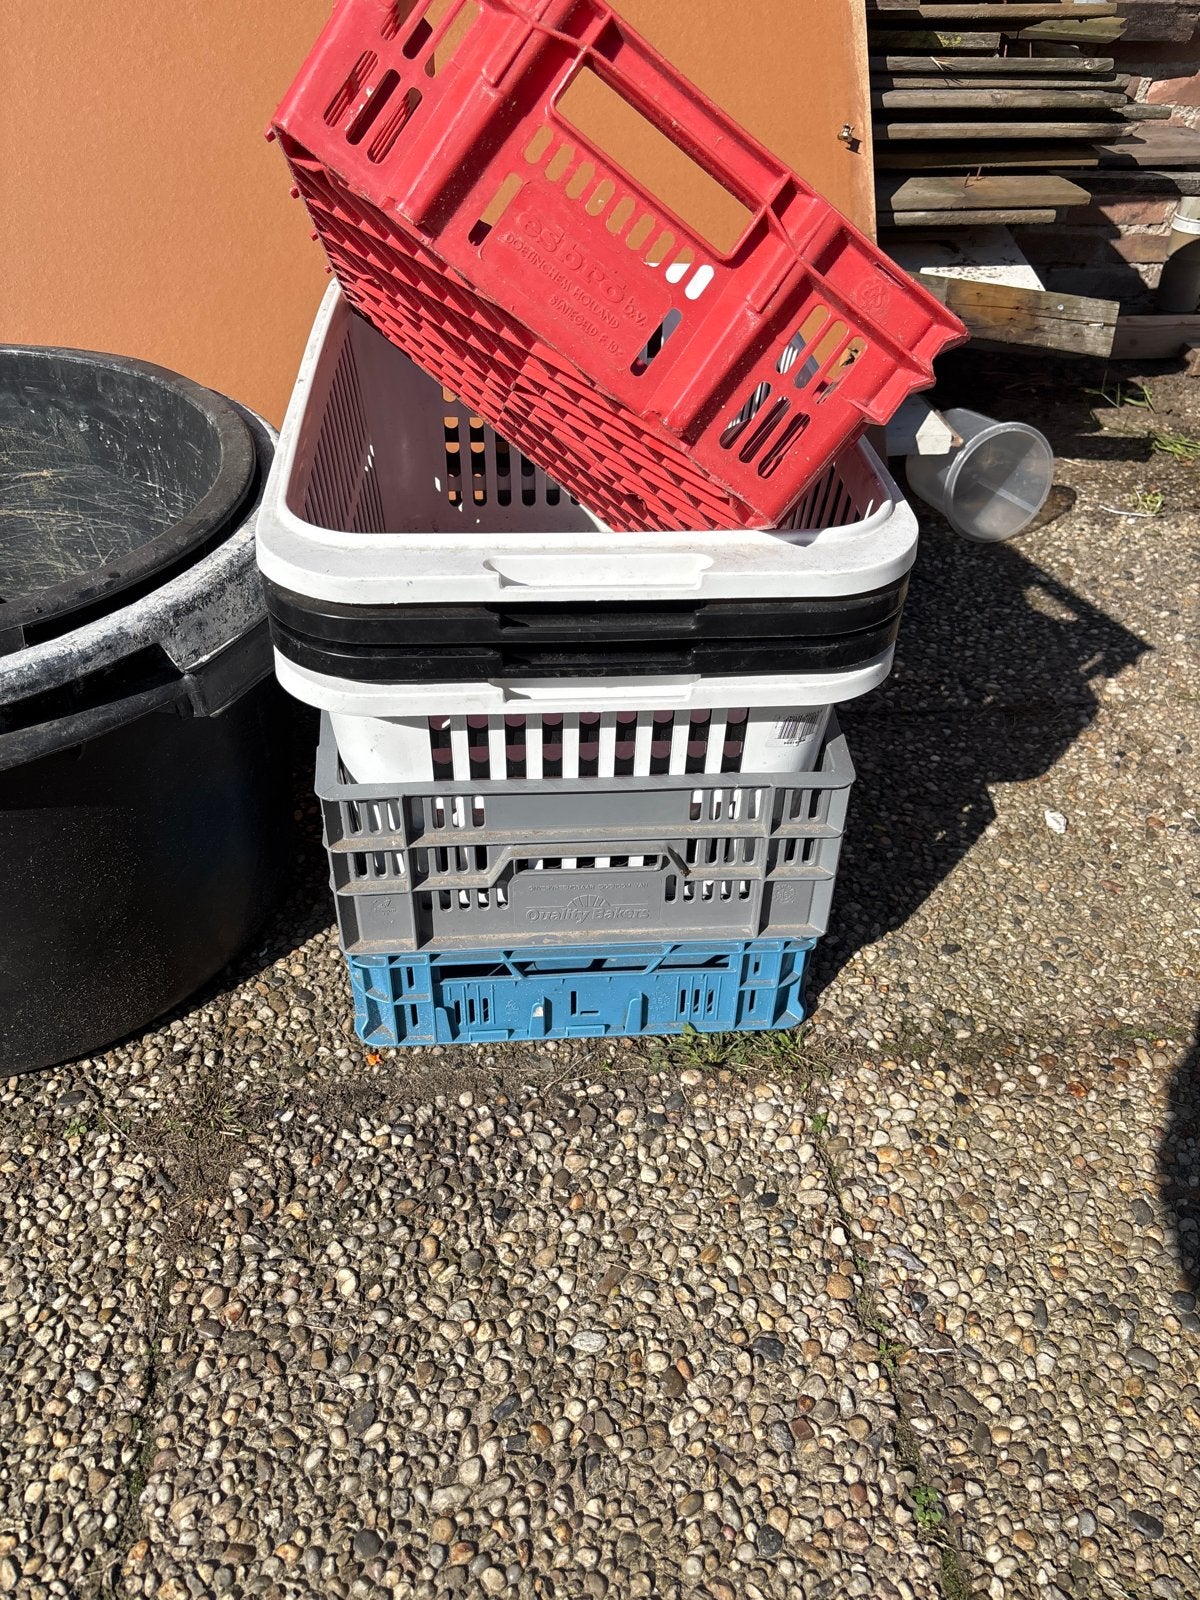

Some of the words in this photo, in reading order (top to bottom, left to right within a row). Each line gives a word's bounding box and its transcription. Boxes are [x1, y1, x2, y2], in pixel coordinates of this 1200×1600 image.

[572, 285, 620, 329] HOLLAND
[526, 905, 590, 924] Quality
[591, 906, 650, 921] Bakers
